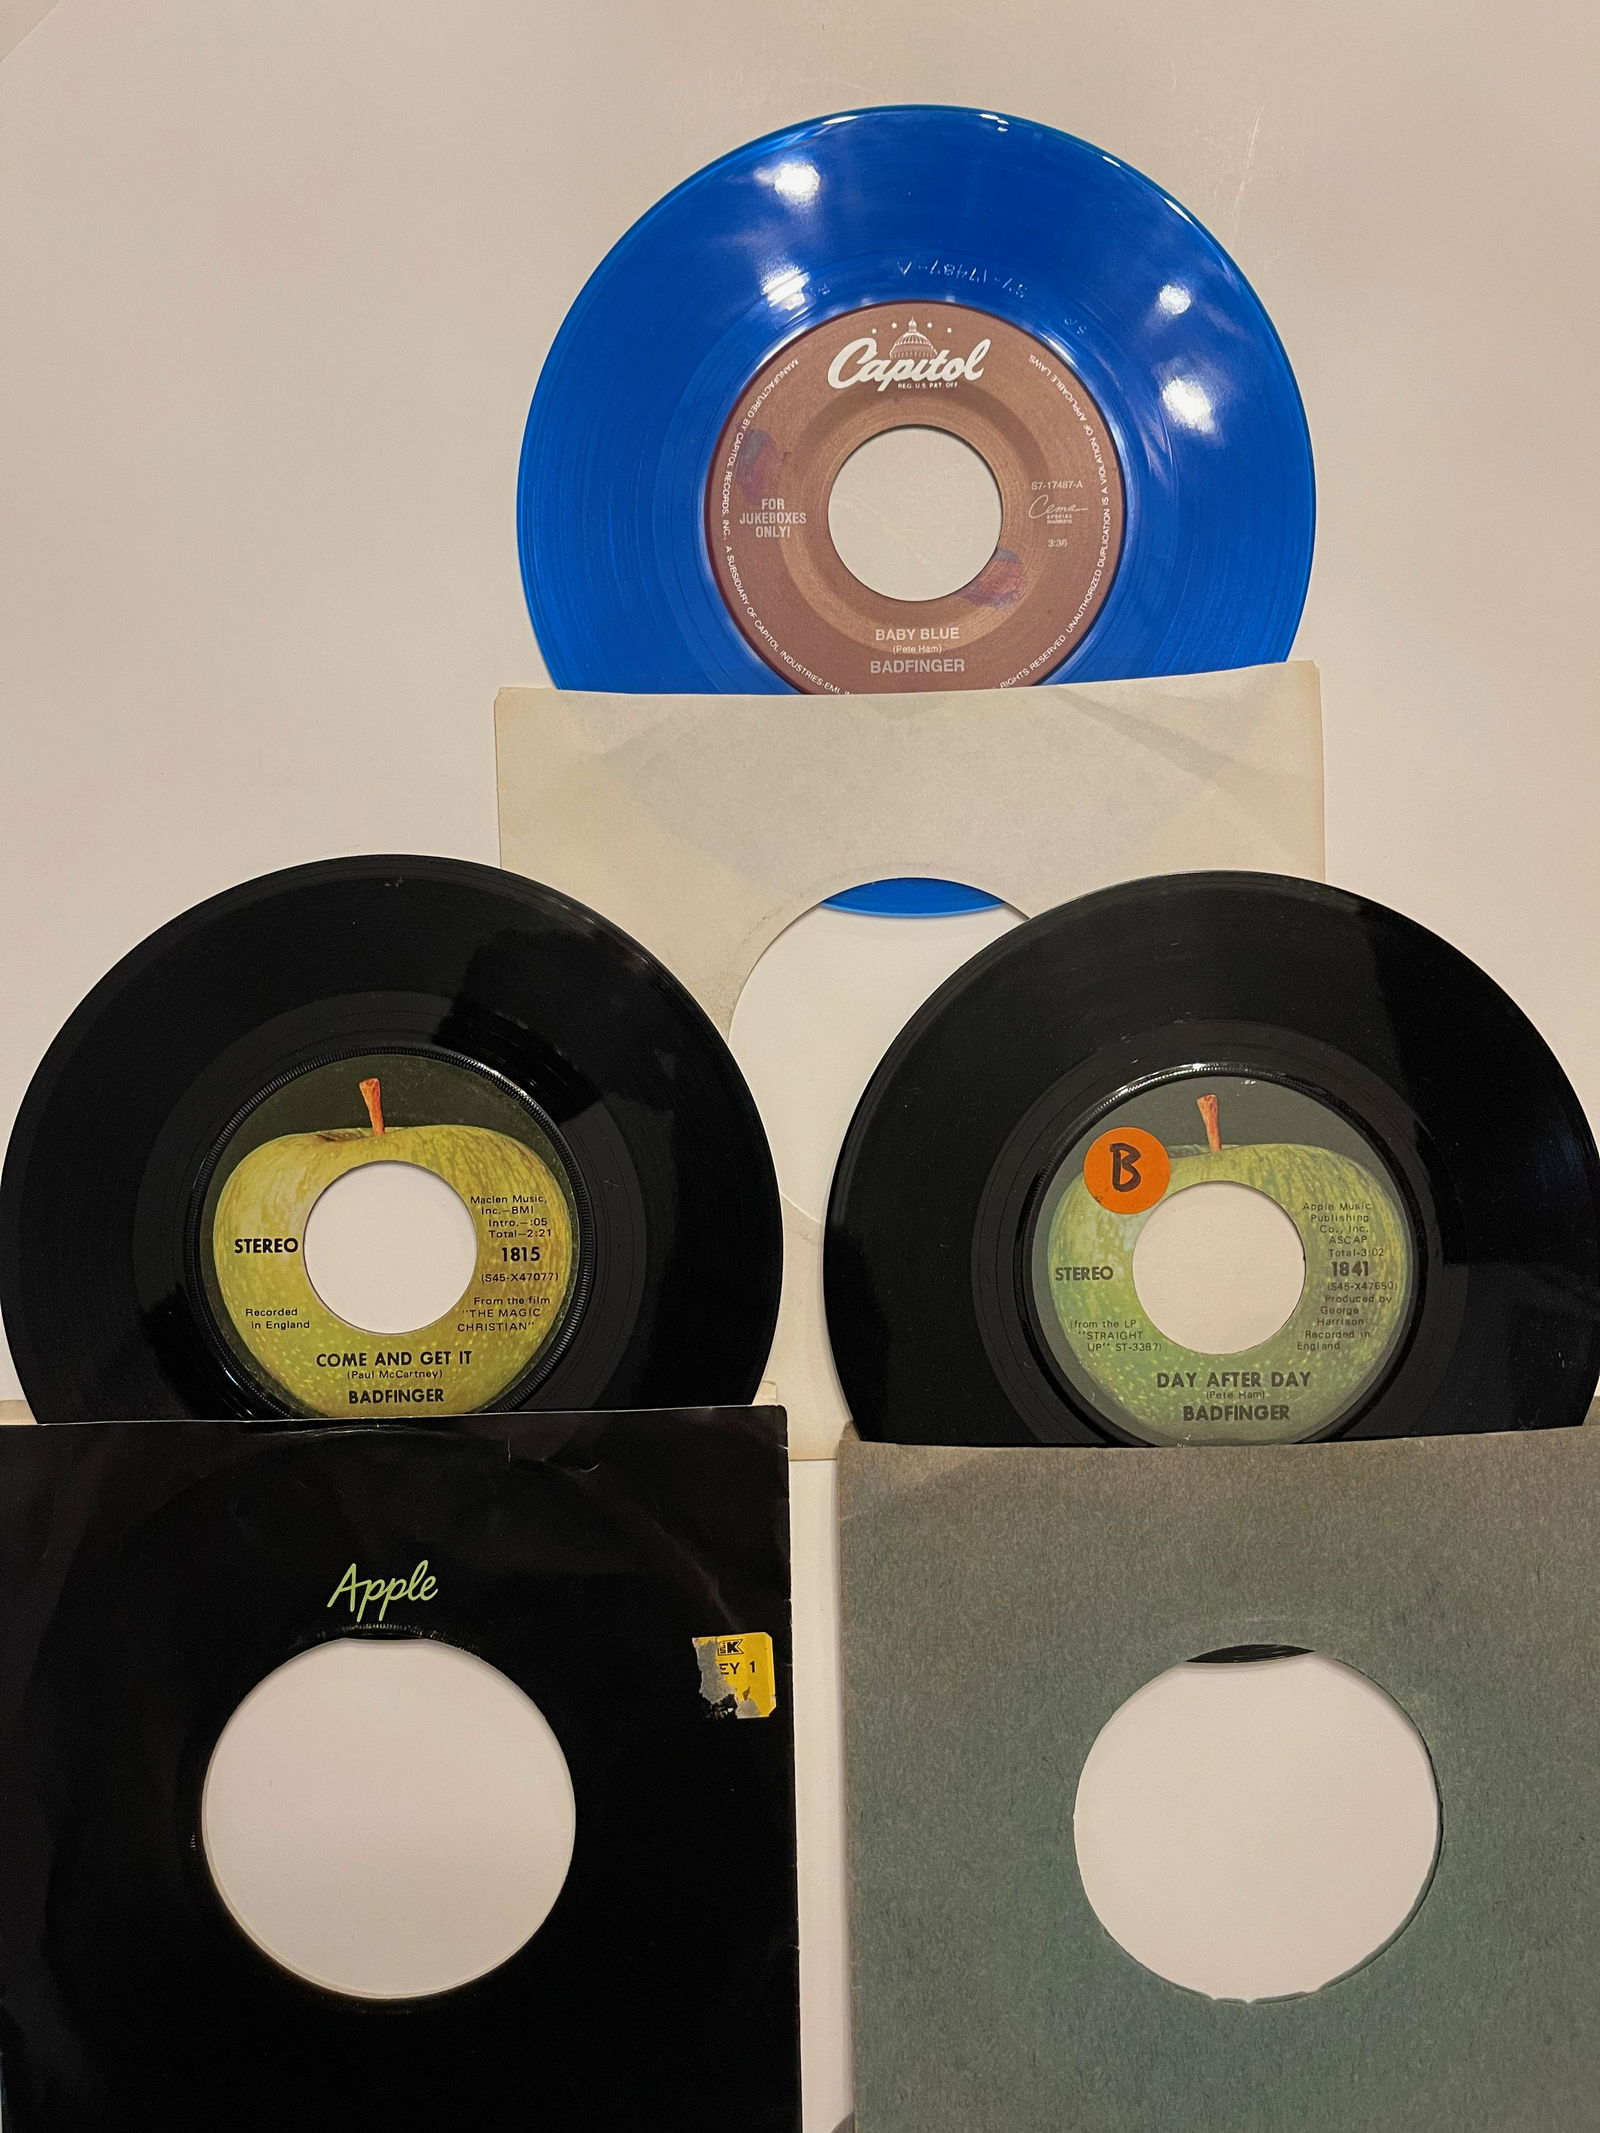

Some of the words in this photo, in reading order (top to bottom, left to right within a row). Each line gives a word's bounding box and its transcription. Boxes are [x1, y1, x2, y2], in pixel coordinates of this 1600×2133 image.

[828, 337, 991, 392] Capitol
[1028, 354, 1052, 377] LAWS
[747, 359, 799, 418] MANUFACTURED
[1051, 374, 1087, 422] APPLICABLE
[741, 418, 751, 431] BY
[1083, 424, 1094, 436] OF
[728, 432, 744, 468] CAPITOL
[1090, 437, 1110, 484] VIOLATION
[1101, 486, 1109, 495] A
[761, 498, 785, 510] FOR
[1028, 494, 1088, 519] Cema
[1101, 496, 1109, 505] IS
[739, 512, 807, 525] JUKEBOXES
[755, 526, 790, 538] ONLY!
[1097, 507, 1111, 568] DUPLICATION
[725, 545, 732, 553] A
[726, 554, 750, 606] SUBSIDIARY
[1066, 569, 1102, 634] UNAUTHORIZED
[746, 606, 757, 619] OF
[754, 619, 780, 652] CAPITOL
[875, 628, 915, 641] BABY
[920, 627, 960, 640] BLUE
[892, 644, 916, 655] (Pete
[918, 643, 942, 655] Ham)
[1029, 634, 1066, 671] RESERVED
[870, 658, 965, 674] BADFINGER
[999, 667, 1030, 689] RIGHTS
[1109, 1142, 1142, 1193] B
[470, 1195, 508, 1204] Maclen
[512, 1194, 547, 1205] Music,
[1302, 1202, 1334, 1212] Apple
[1339, 1202, 1372, 1211] Music
[1310, 1214, 1370, 1223] Publishing
[1319, 1225, 1343, 1234] Co.,
[1348, 1225, 1369, 1233] Inc.
[234, 1237, 299, 1254] STEREO
[1328, 1236, 1368, 1245] ASCAP
[501, 1246, 541, 1262] 1815
[1055, 1265, 1114, 1282] STEREO
[1331, 1261, 1369, 1277] 1841
[481, 1272, 559, 1284] (S45-X47077)
[474, 1296, 504, 1306] From
[507, 1296, 525, 1305] the
[528, 1295, 550, 1304] film
[1325, 1294, 1374, 1303] Produced
[1379, 1294, 1392, 1304] by
[245, 1308, 298, 1317] Recorded
[498, 1308, 541, 1317] MAGIC
[1320, 1305, 1359, 1316] George
[251, 1321, 261, 1329] in
[265, 1320, 310, 1331] England
[1102, 1319, 1120, 1328] the
[1124, 1319, 1137, 1328] LP
[1317, 1317, 1364, 1326] Harrison
[1305, 1330, 1354, 1339] Recorded
[1360, 1330, 1371, 1338] in
[1115, 1342, 1162, 1352] ST-3387)
[1297, 1341, 1340, 1351] England
[316, 1352, 367, 1367] COME
[375, 1351, 412, 1366] AND
[419, 1351, 452, 1365] GET
[459, 1350, 472, 1365] IT
[347, 1370, 375, 1380] (Paul
[379, 1369, 443, 1379] McCartney)
[1157, 1371, 1197, 1388] DAY
[1206, 1371, 1262, 1388] AFTER
[1271, 1371, 1311, 1387] DAY
[348, 1388, 444, 1404] BADFINGER
[1206, 1391, 1234, 1400] (Pete
[1238, 1390, 1265, 1400] Ham)
[1182, 1404, 1290, 1421] BADFINGER
[327, 1559, 439, 1623] Apple
[749, 1660, 756, 1673] 1
